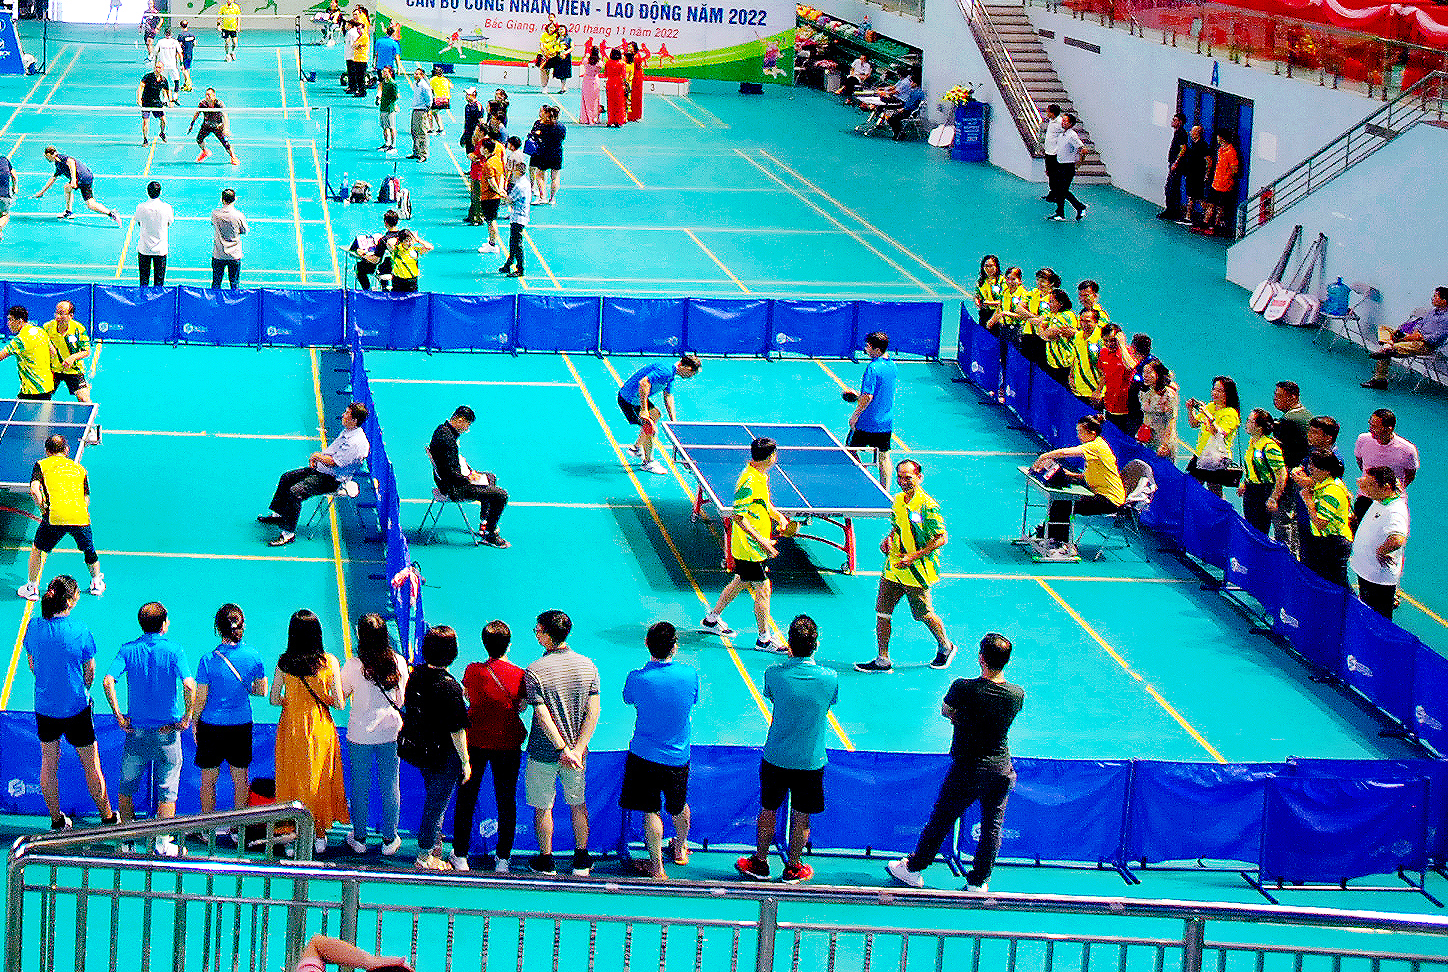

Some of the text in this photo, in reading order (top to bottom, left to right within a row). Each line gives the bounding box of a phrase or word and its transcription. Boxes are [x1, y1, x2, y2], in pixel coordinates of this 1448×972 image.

[606, 1, 635, 19] LAO
[639, 0, 682, 24] ĐỘNG
[686, 3, 724, 24] NĂM
[728, 9, 768, 26] 2022
[506, 19, 538, 34] Giang,
[616, 26, 626, 36] 11
[629, 26, 652, 37] năm
[654, 27, 680, 39] 2022
